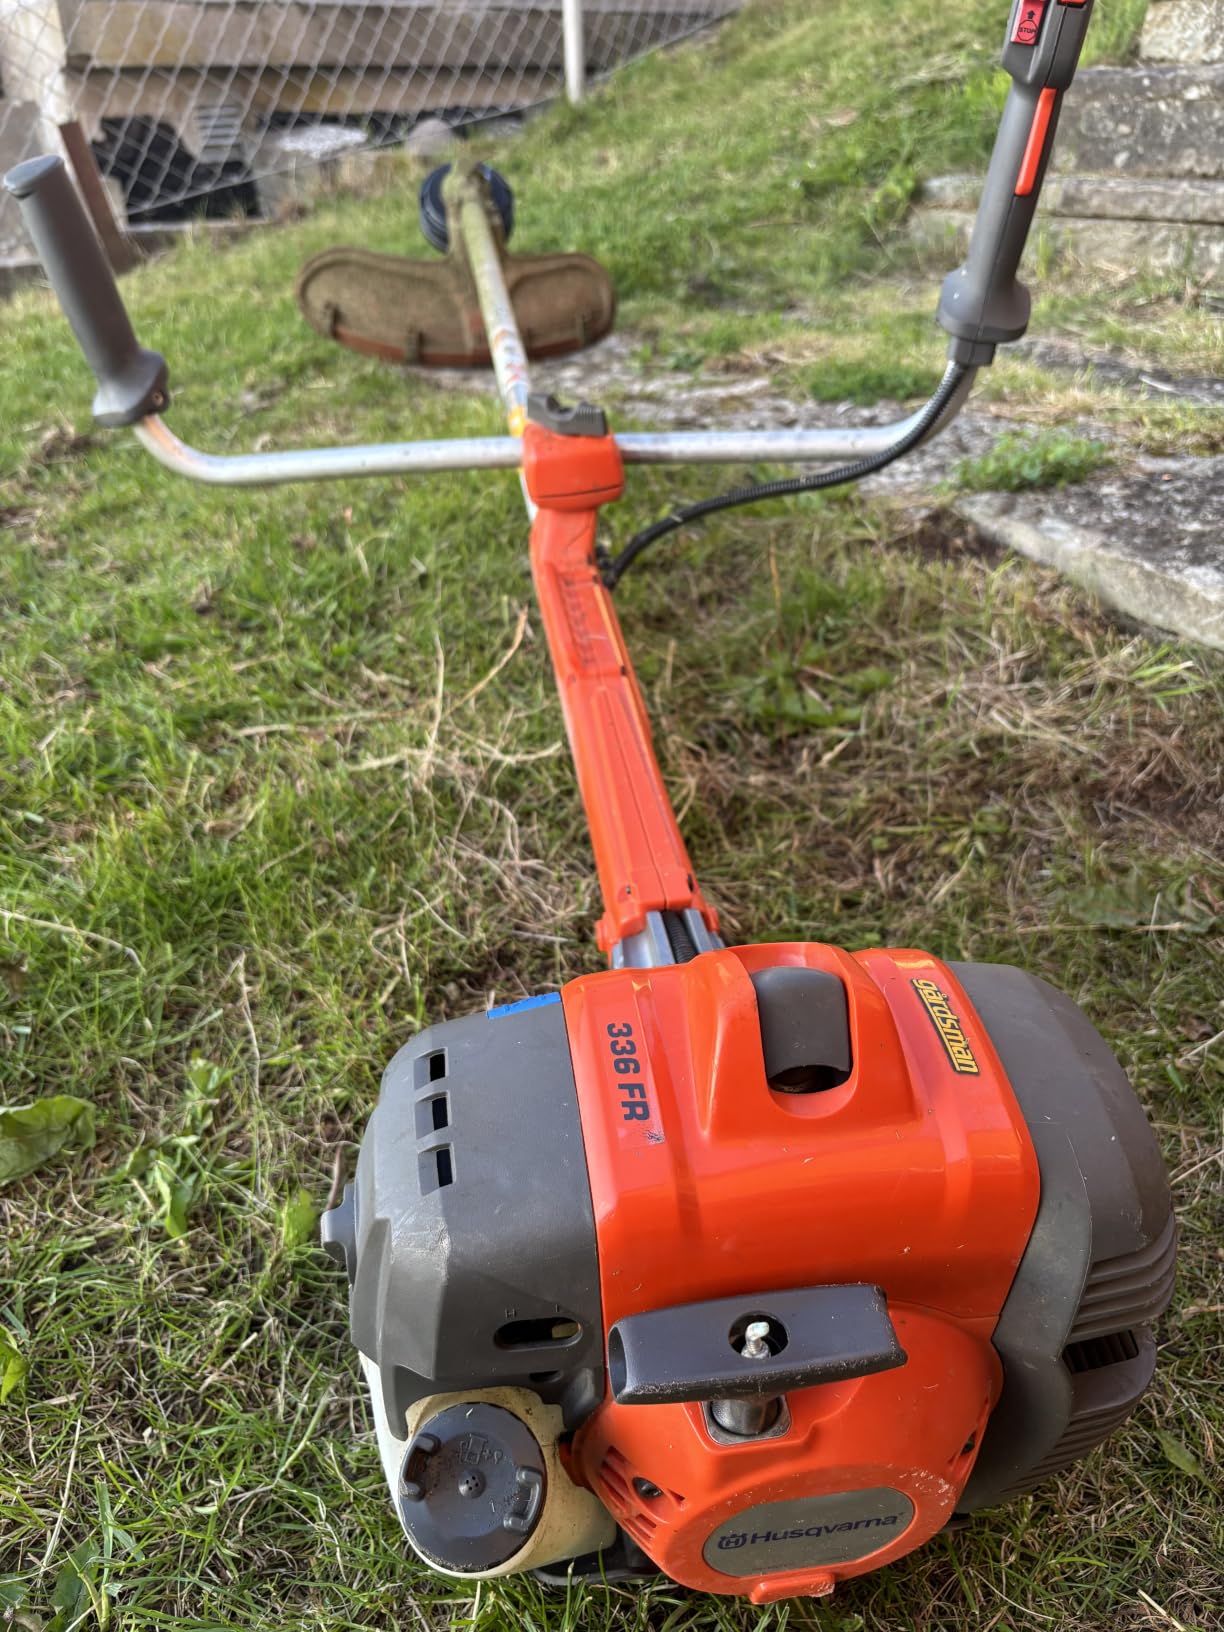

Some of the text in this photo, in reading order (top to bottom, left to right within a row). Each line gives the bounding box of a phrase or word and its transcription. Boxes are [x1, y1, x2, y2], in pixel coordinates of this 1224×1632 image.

[607, 1023, 650, 1121] 336 FR
[911, 978, 979, 1073] gårdsman
[750, 1515, 898, 1544] Husqvarna
